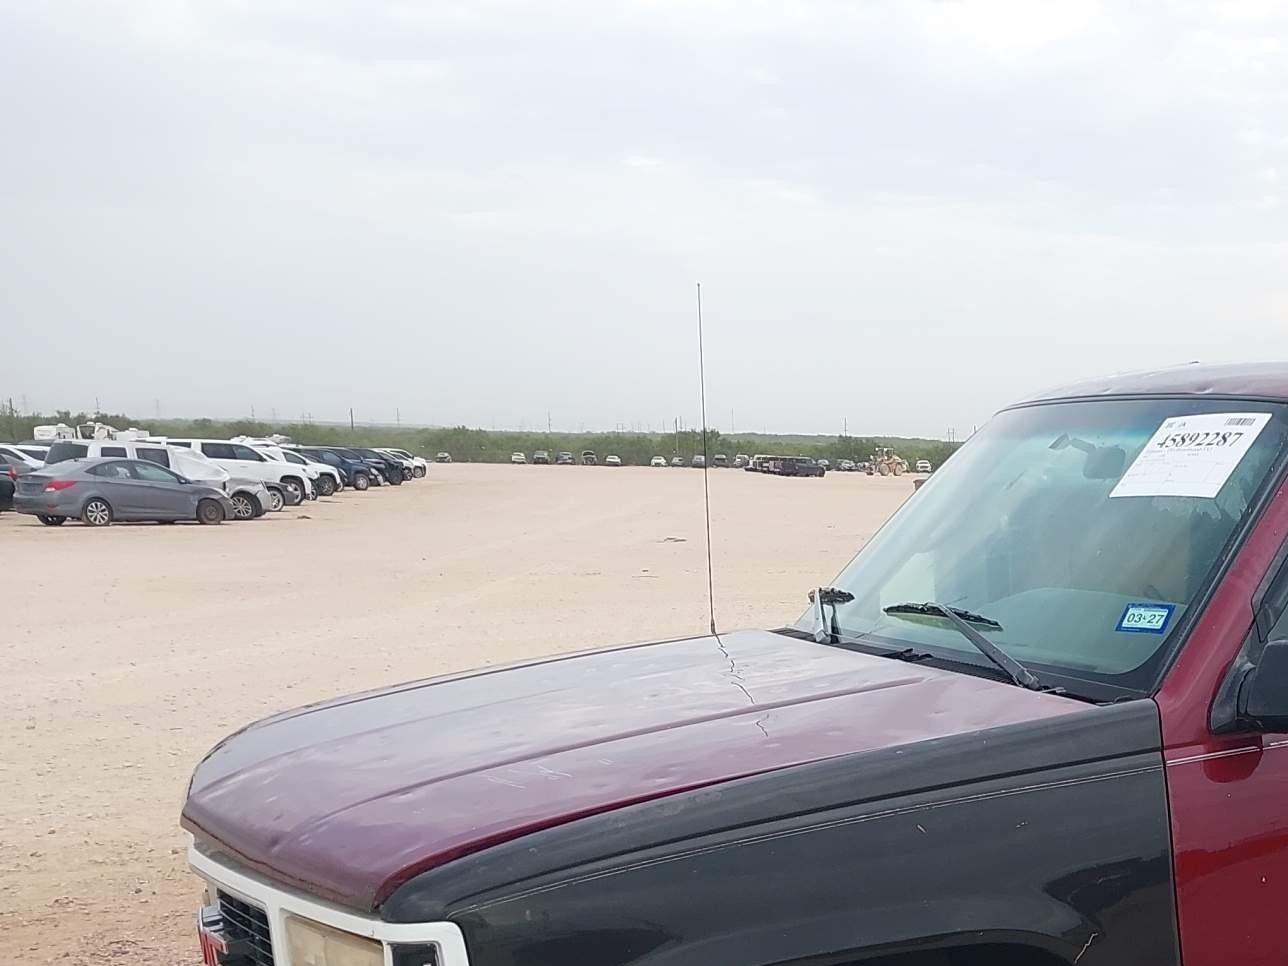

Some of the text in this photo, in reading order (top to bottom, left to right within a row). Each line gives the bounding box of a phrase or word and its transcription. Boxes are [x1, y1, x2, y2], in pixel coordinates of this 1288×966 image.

[1157, 431, 1244, 449] 45892287
[1126, 612, 1165, 625] 03 27
